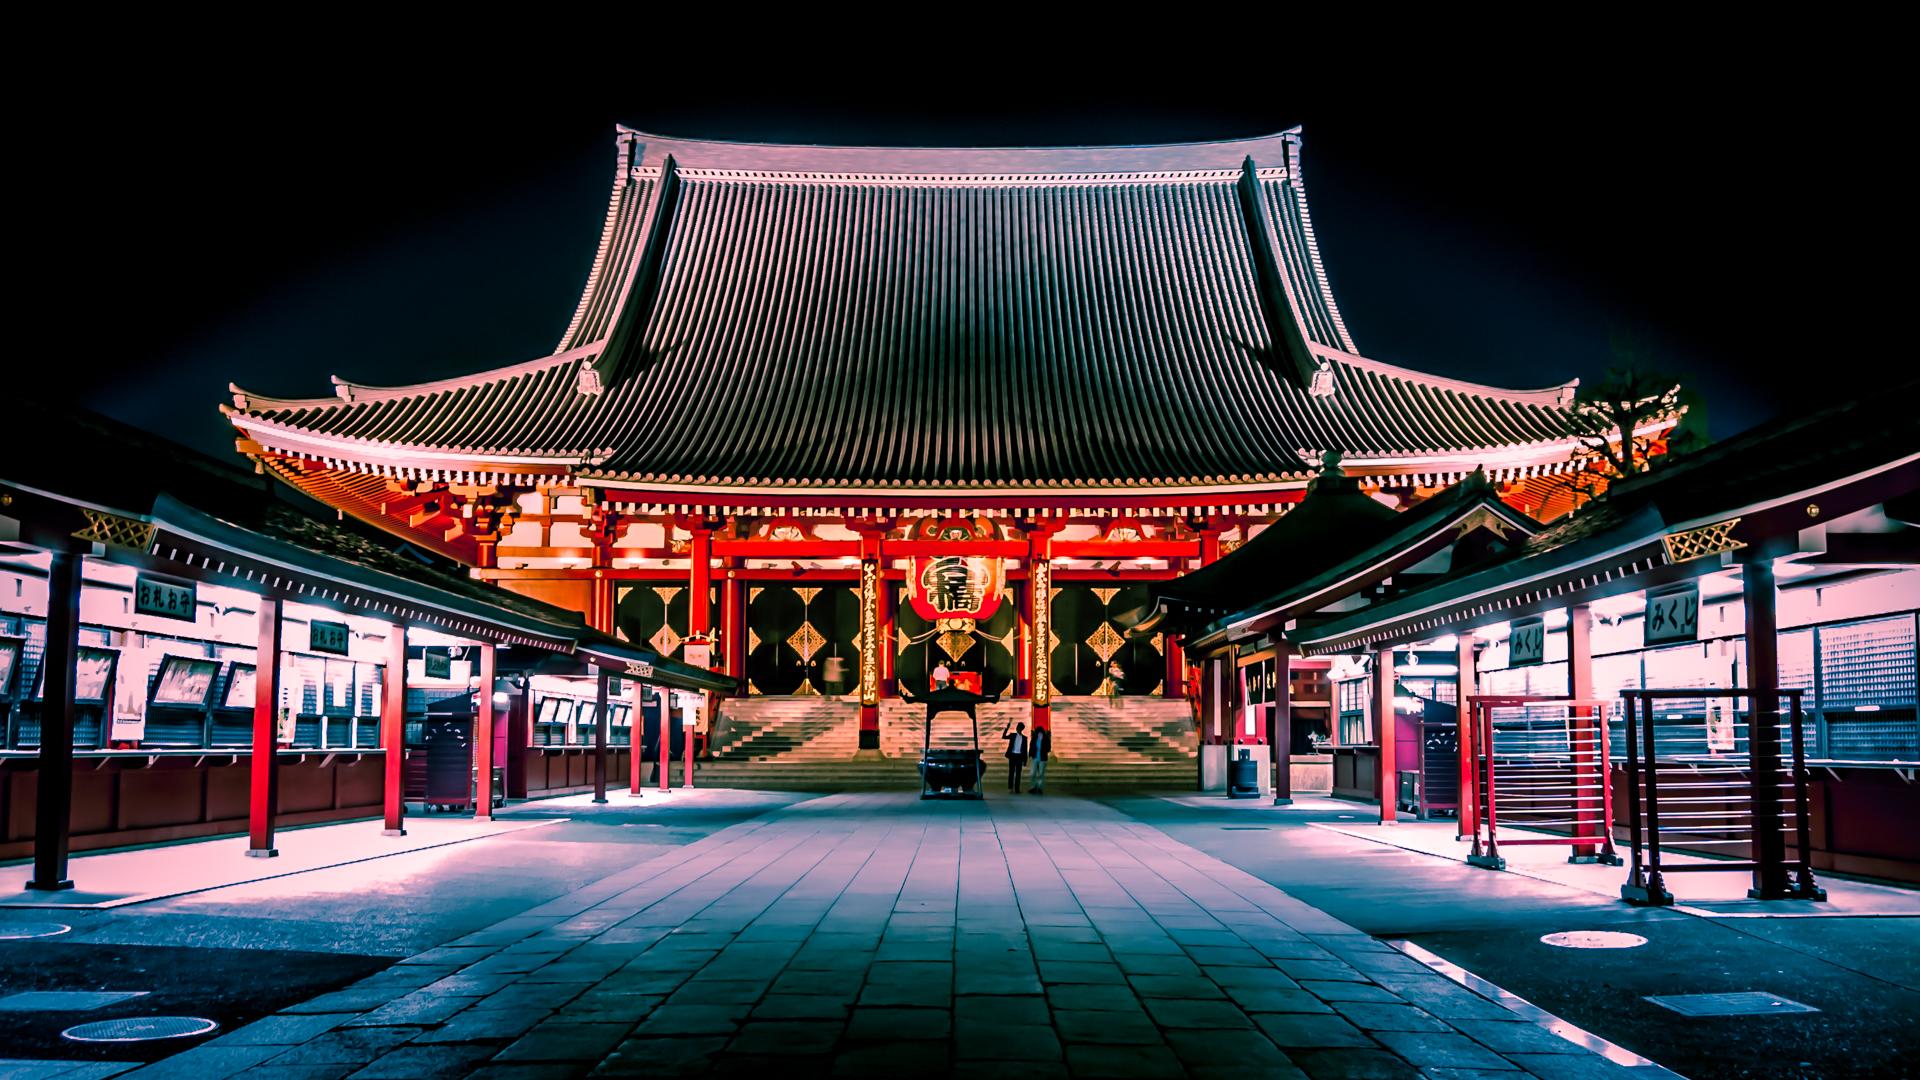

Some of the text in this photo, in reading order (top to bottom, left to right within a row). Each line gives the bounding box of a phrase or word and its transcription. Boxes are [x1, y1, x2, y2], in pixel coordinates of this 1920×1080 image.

[141, 582, 190, 614] お札お守
[1651, 596, 1696, 632] みくじ
[1514, 625, 1543, 655] みくじ
